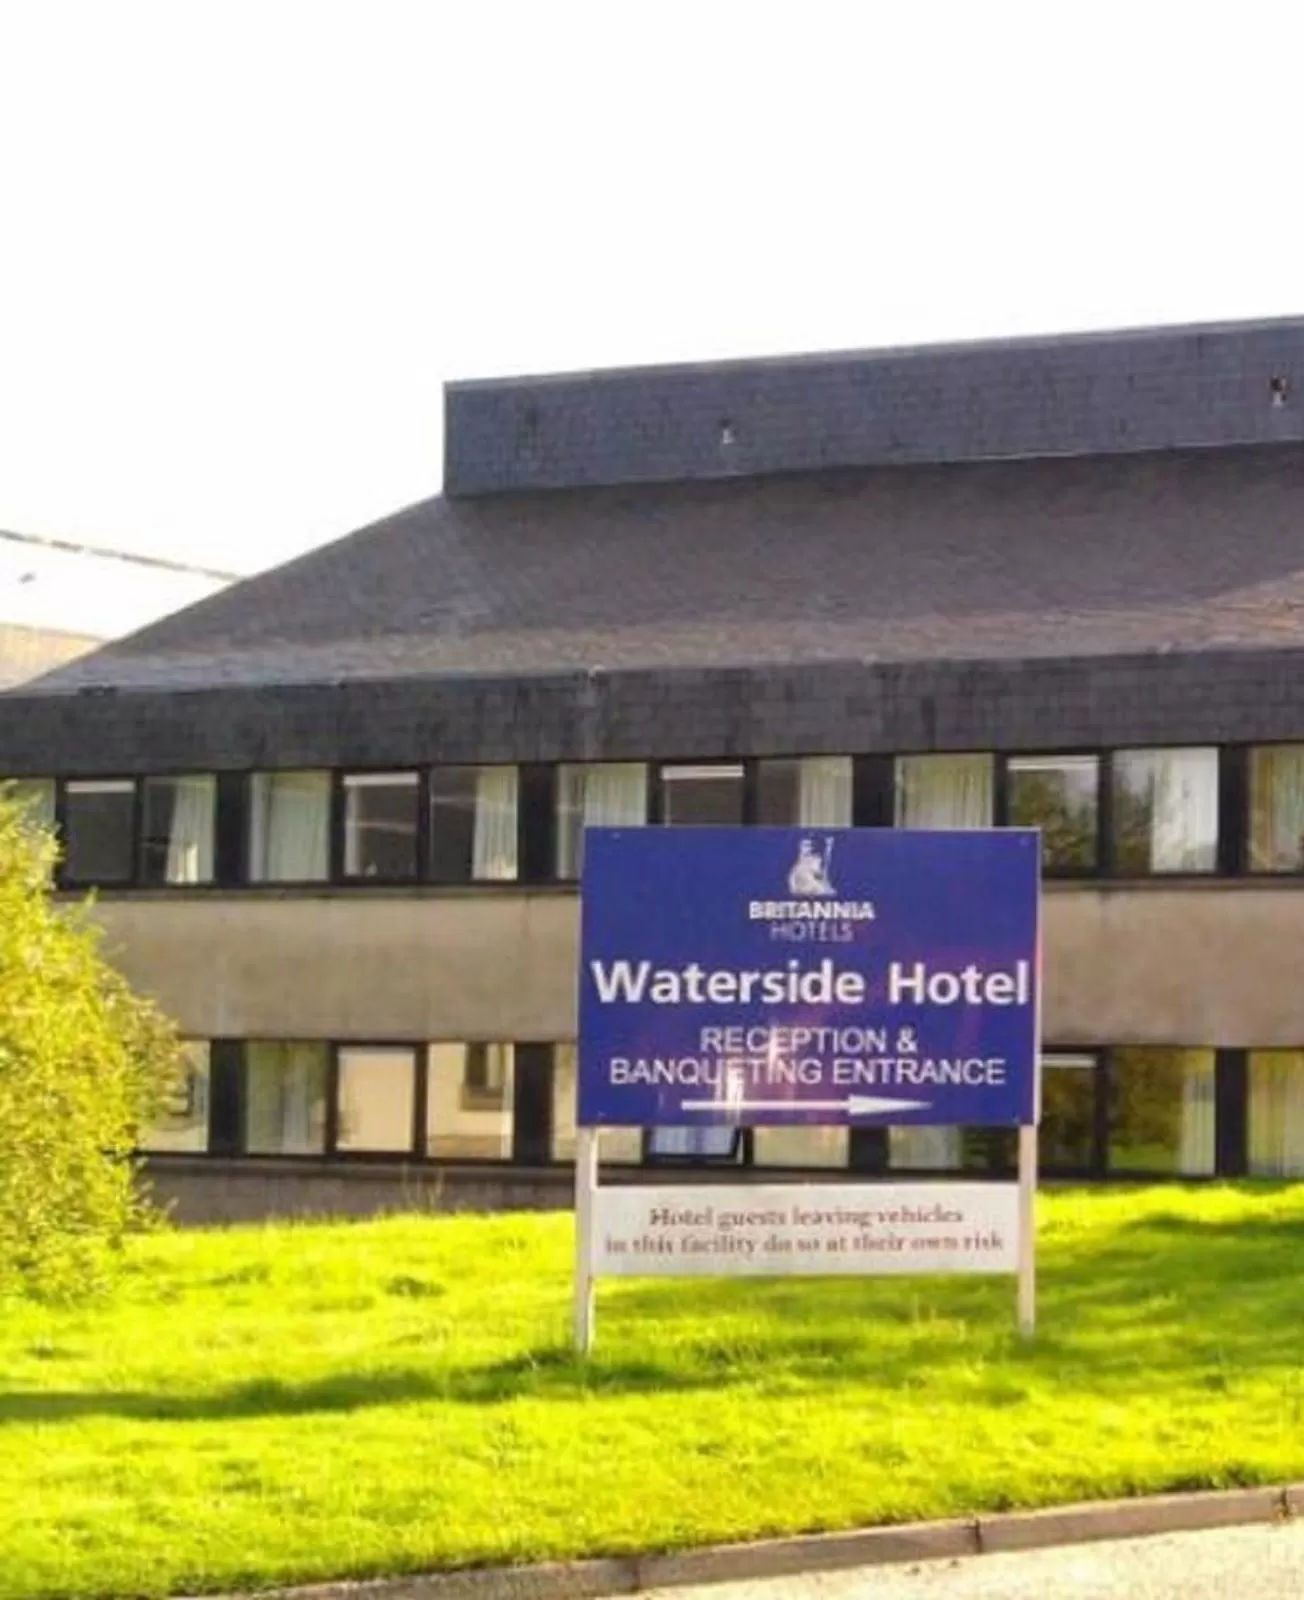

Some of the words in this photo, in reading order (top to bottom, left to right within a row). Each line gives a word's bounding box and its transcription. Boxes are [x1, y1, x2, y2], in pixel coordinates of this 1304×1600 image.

[750, 901, 876, 920] BRITANNIA
[770, 921, 853, 942] HOTELS
[591, 958, 864, 1004] Waterside
[890, 960, 1029, 1004] Hotel
[700, 1027, 886, 1053] RECEPTION
[897, 1027, 918, 1054] &
[610, 1058, 821, 1085] BANQUETING
[832, 1059, 1006, 1084] ENTRANCE
[650, 1207, 713, 1226] Hotel
[717, 1209, 787, 1231] guests
[793, 1205, 871, 1229] leaving
[877, 1204, 963, 1223] vehicles
[606, 1235, 627, 1252] in
[632, 1234, 674, 1252] this
[680, 1233, 756, 1253] facility
[763, 1233, 792, 1252] do
[826, 1235, 847, 1252] at
[853, 1232, 903, 1251] their
[910, 1235, 958, 1250] own
[964, 1230, 1003, 1250] risk
